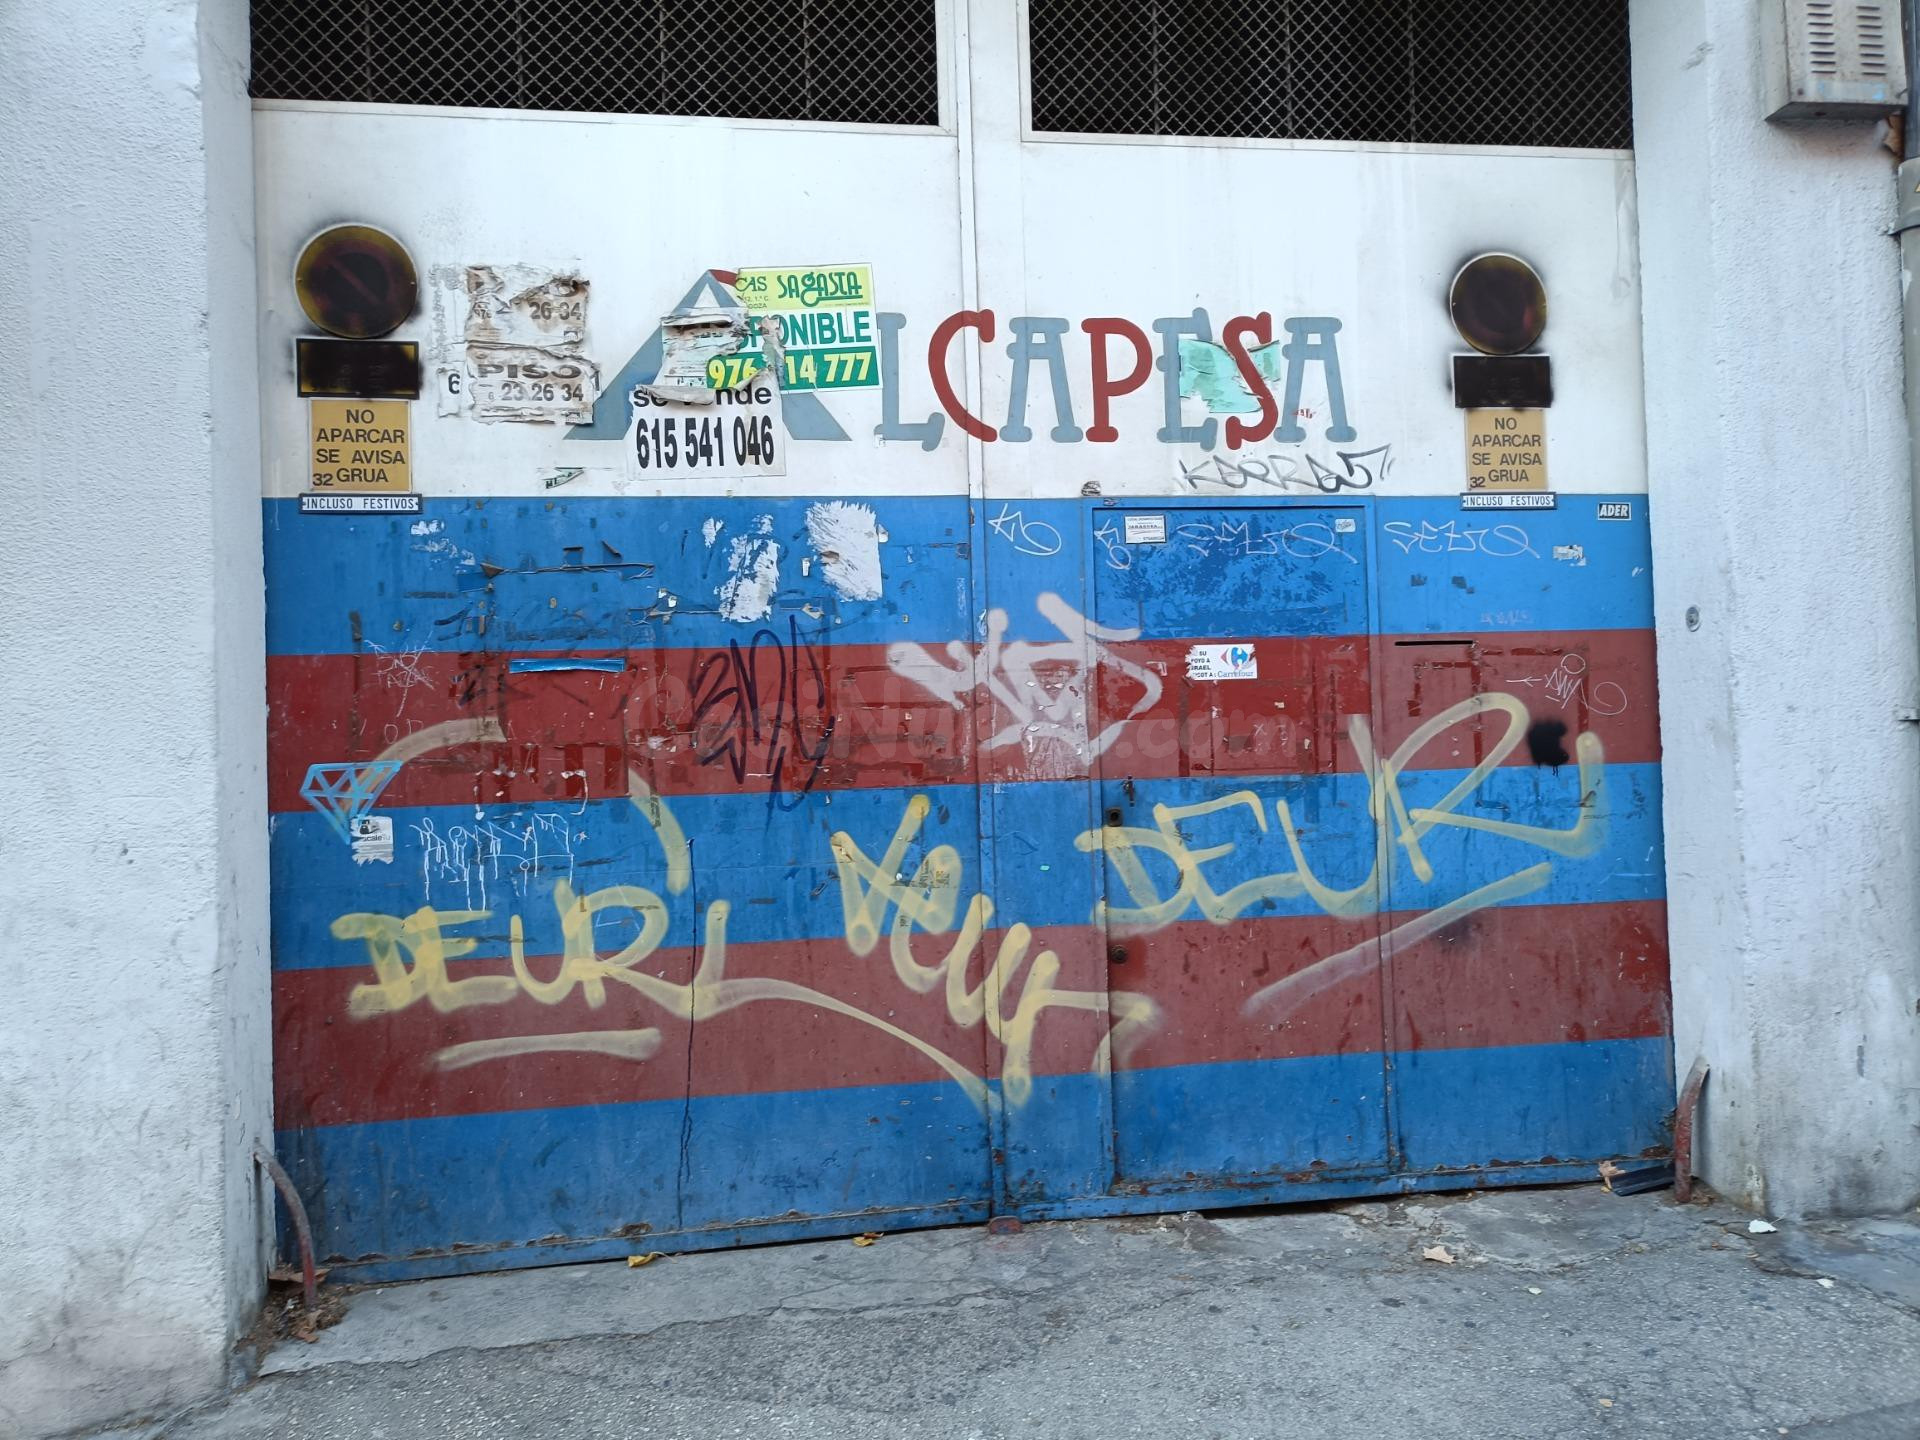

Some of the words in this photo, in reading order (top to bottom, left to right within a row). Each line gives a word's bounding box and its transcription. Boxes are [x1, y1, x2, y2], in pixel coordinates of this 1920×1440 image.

[529, 302, 552, 320] 26
[476, 364, 581, 379] PISO
[823, 352, 873, 383] 777
[531, 384, 554, 402] 26
[561, 384, 583, 402] 34
[346, 408, 374, 424] NO
[1494, 417, 1517, 430] NO
[316, 428, 405, 444] APARCAR
[636, 417, 677, 469] 615
[685, 416, 724, 468] 541
[733, 415, 775, 466] 046
[1472, 434, 1541, 447] APARCAR
[316, 449, 340, 464] SE
[351, 449, 405, 465] AVISA
[1472, 452, 1491, 466] SE
[1499, 452, 1542, 466] AVISA
[312, 473, 333, 487] 32
[336, 467, 389, 483] GRUA
[1469, 476, 1485, 488] 32
[1488, 469, 1529, 483] GRUA
[305, 498, 353, 510] INCLUSO
[363, 497, 415, 509] FESTIVOS
[1465, 495, 1503, 506] INCLUSO
[1510, 495, 1551, 506] FESTIVOS
[1599, 504, 1629, 517] ADER
[1217, 670, 1254, 678] Carrefour
